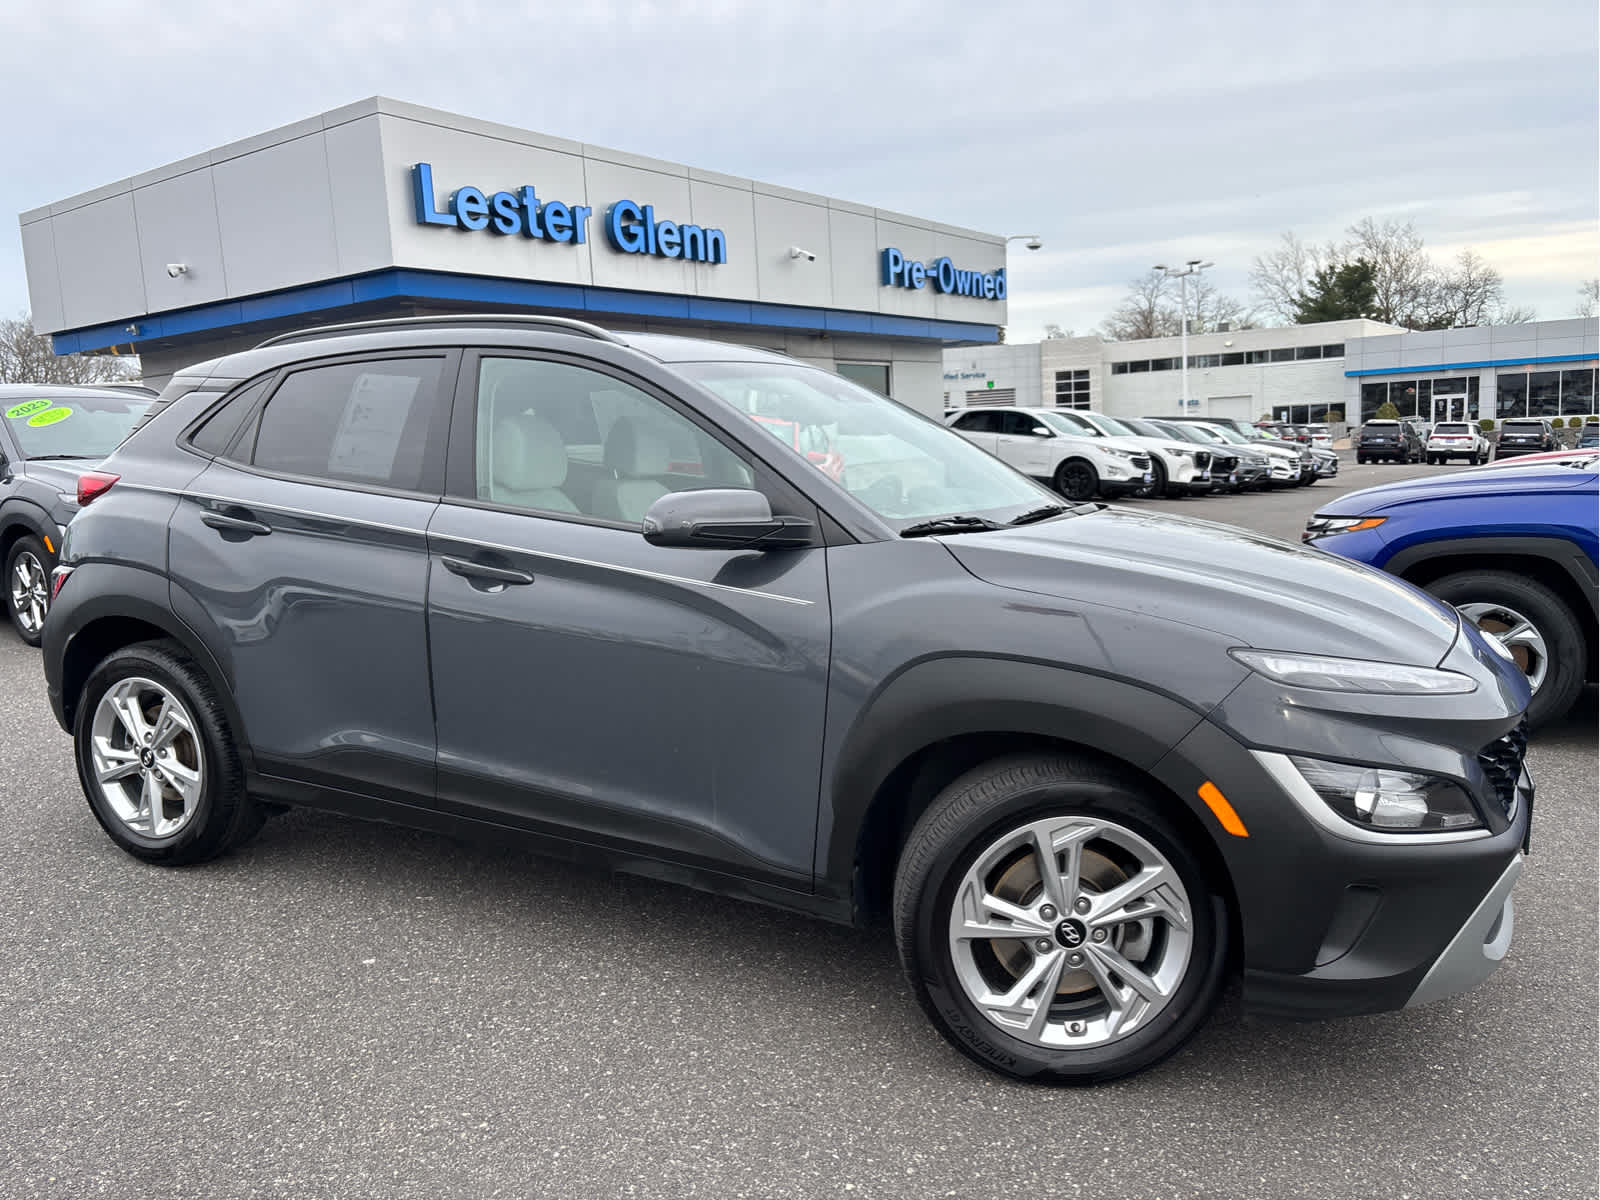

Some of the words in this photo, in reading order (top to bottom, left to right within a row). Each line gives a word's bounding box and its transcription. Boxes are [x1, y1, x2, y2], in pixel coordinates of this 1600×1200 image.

[408, 162, 592, 245] Lester
[606, 199, 727, 264] Glenn
[881, 248, 1007, 300] Pre-Owned
[11, 400, 48, 416] 2023
